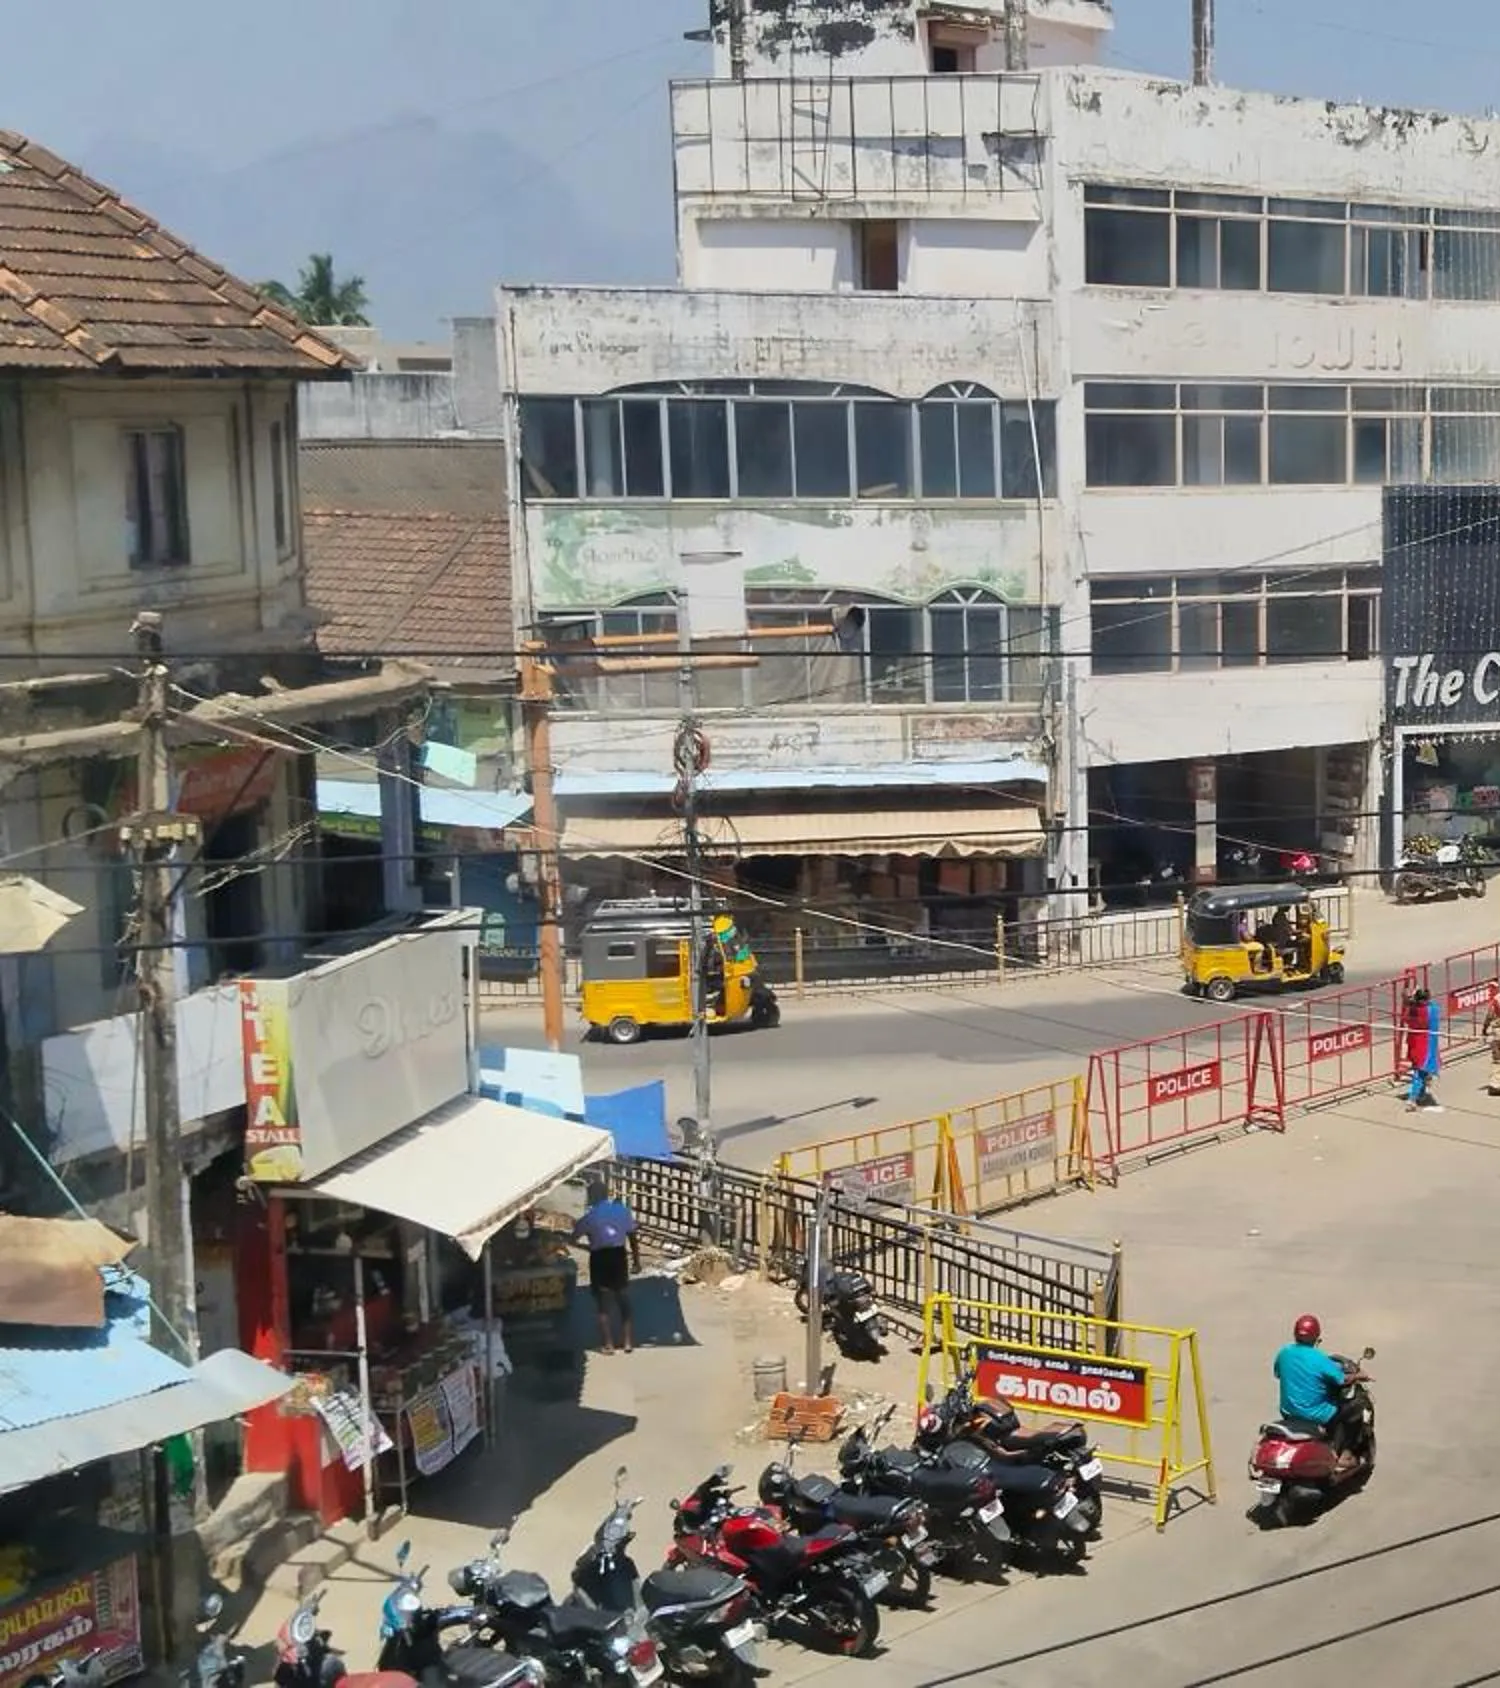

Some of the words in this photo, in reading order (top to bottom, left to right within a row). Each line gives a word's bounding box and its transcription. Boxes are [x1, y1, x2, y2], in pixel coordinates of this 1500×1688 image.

[1393, 655, 1466, 707] The
[1313, 1030, 1365, 1056] POLICE
[244, 1009, 287, 1127] TEA
[1156, 1068, 1212, 1098] POLICE
[245, 1128, 300, 1143] STALL
[986, 1121, 1049, 1152] POLICE
[995, 1373, 1121, 1413] காவல்
